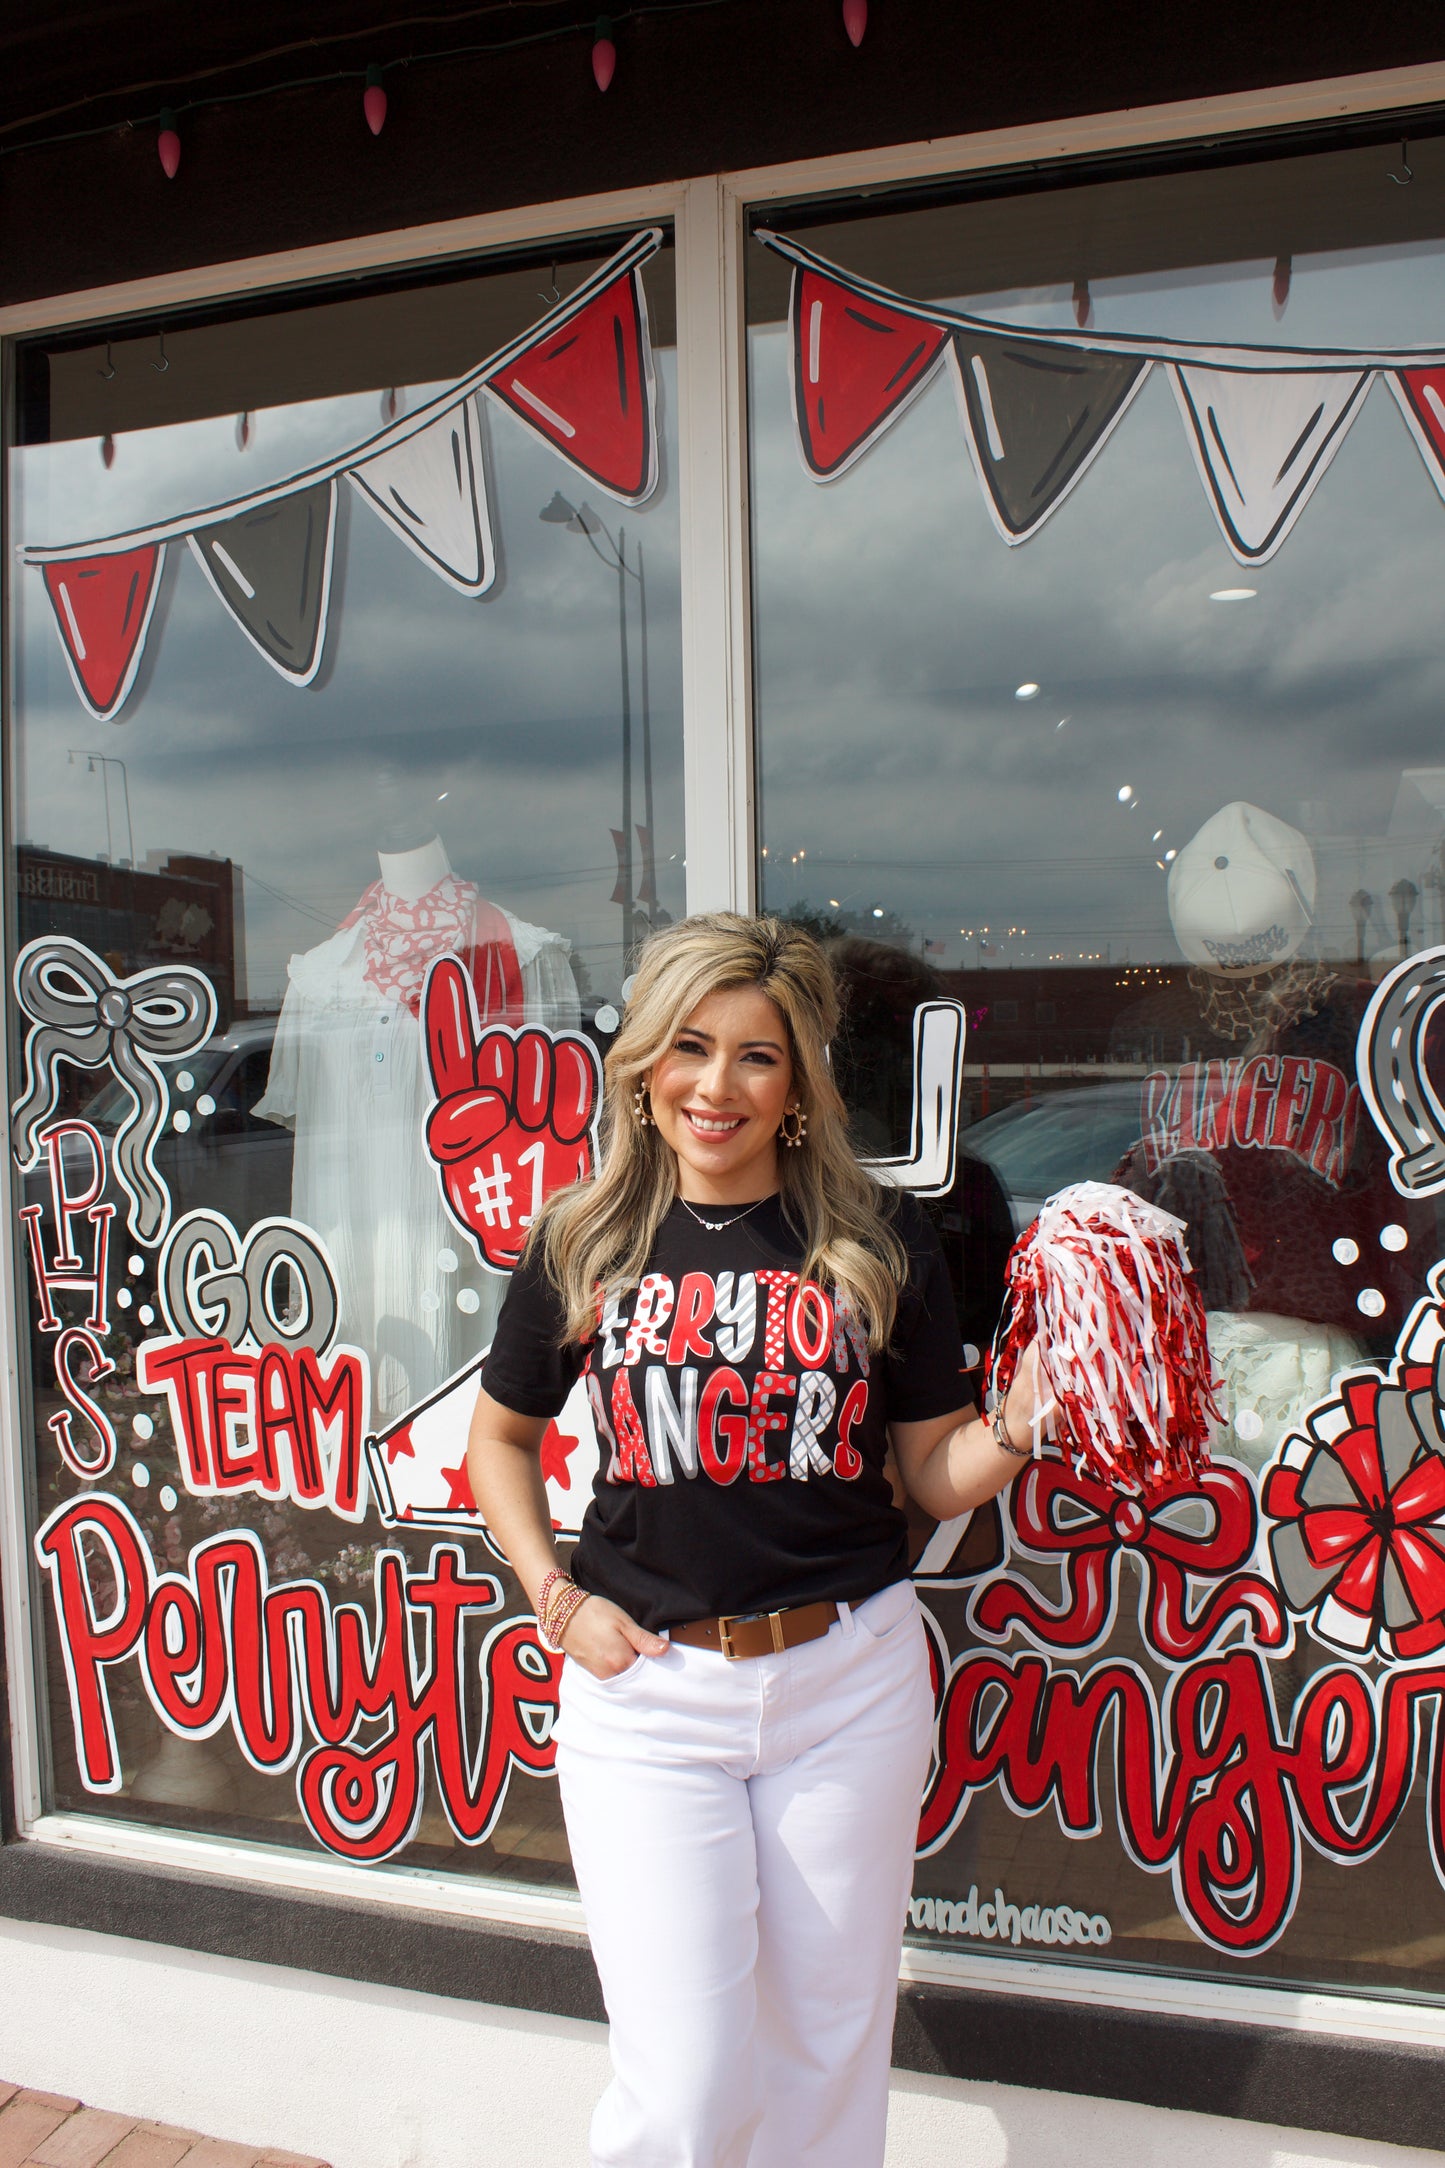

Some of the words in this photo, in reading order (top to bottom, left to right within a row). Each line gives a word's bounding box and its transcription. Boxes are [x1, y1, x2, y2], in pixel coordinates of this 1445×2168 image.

[469, 1141, 545, 1229] #1
[158, 1208, 341, 1352] GO
[581, 1269, 871, 1377] ERRYTON
[135, 1336, 370, 1522] TEAM
[34, 1491, 563, 1865] Perryto
[914, 1604, 1445, 1957] anger
[904, 1884, 1113, 1945] andchaosco
